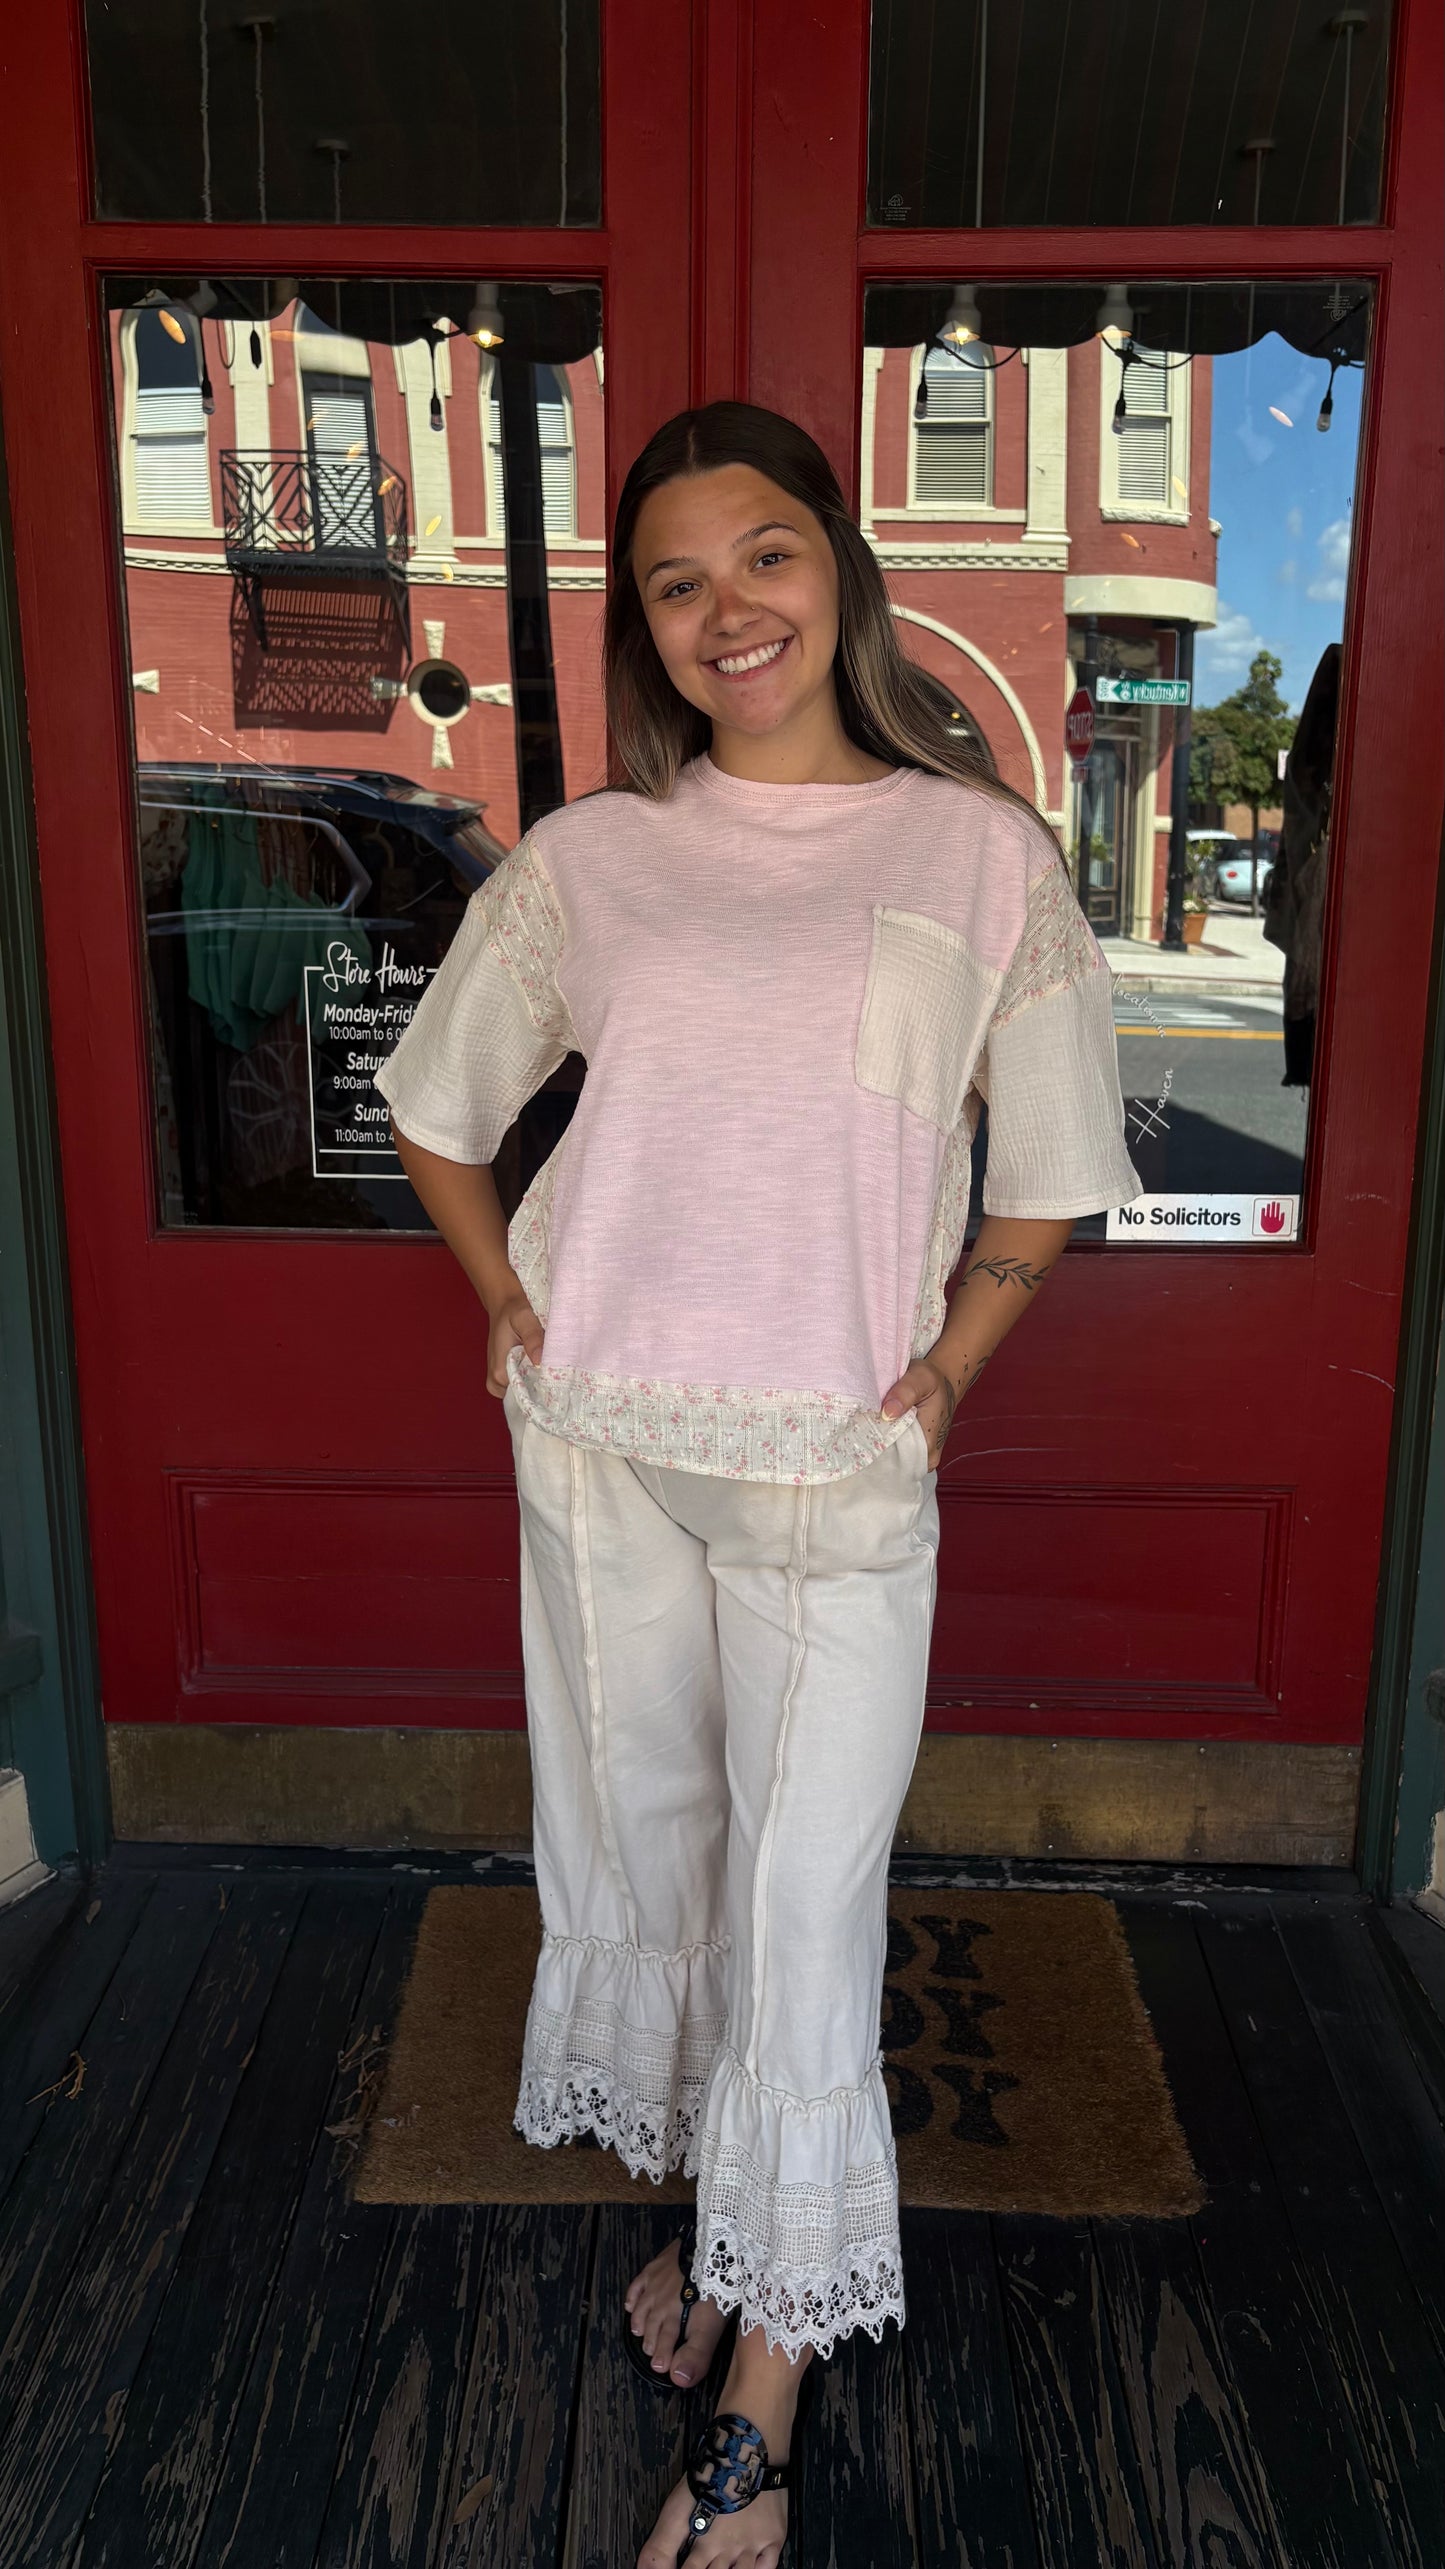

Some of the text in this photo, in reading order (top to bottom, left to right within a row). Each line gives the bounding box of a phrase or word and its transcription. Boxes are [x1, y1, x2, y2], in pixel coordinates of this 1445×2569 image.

[322, 940, 427, 994] Store Hours
[323, 1003, 417, 1027] Monday-Frid
[328, 1026, 372, 1040] 10:00am
[373, 1027, 385, 1041] to
[346, 1051, 394, 1071] Satur
[332, 1075, 372, 1090] 9:00am
[1127, 1068, 1174, 1144] Haven
[334, 1128, 374, 1143] 11:00am
[375, 1130, 387, 1143] to
[1118, 1206, 1242, 1227] No Solicitors
